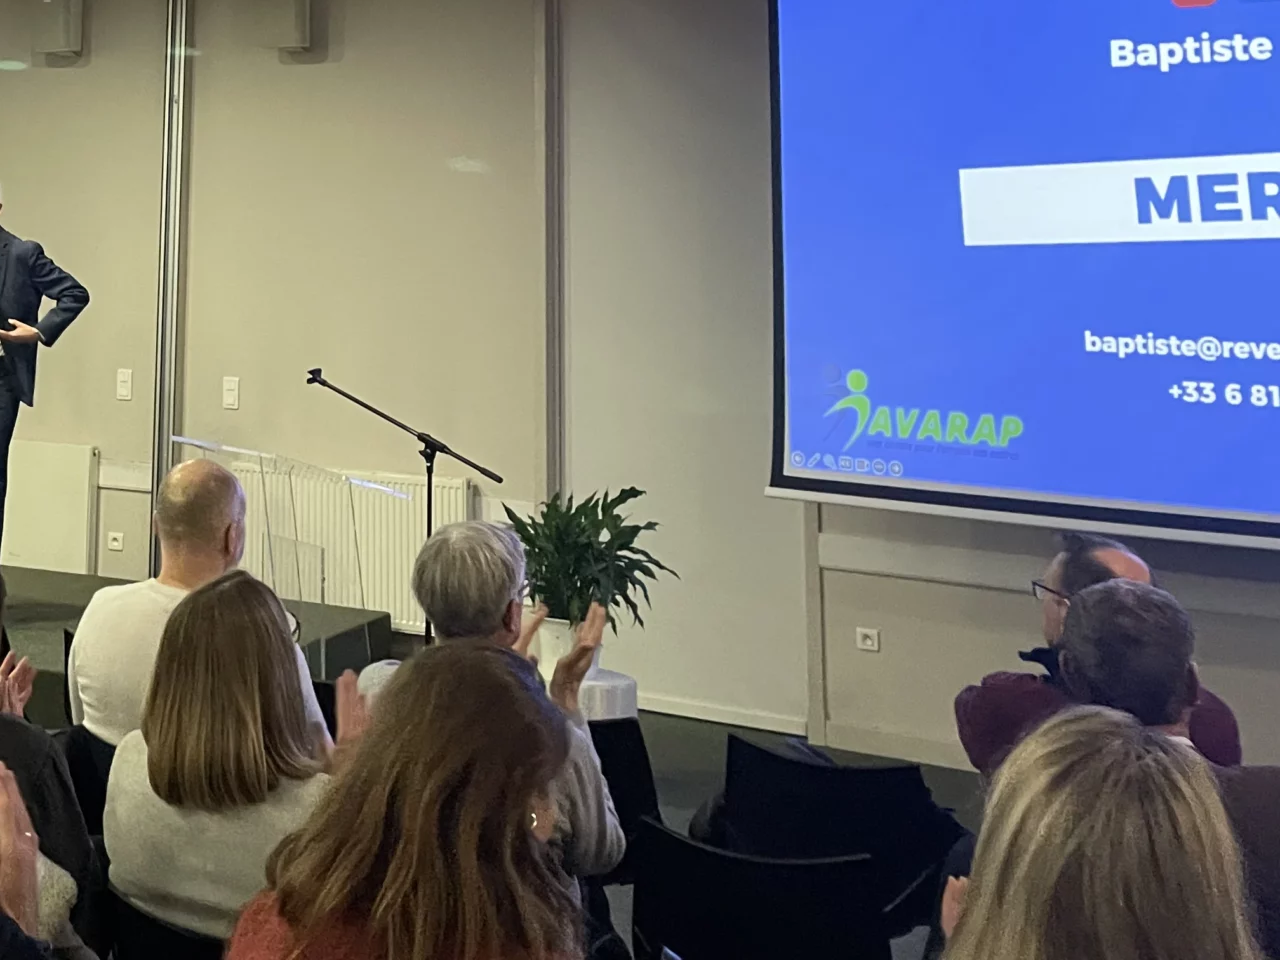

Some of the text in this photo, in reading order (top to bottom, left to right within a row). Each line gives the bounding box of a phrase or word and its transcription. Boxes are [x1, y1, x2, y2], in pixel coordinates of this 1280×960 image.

[1110, 31, 1273, 72] Baptiste
[1134, 171, 1280, 224] MER
[1084, 330, 1280, 361] baptiste@reve
[1168, 381, 1280, 407] +33 6 81
[868, 406, 1024, 447] AVARAP
